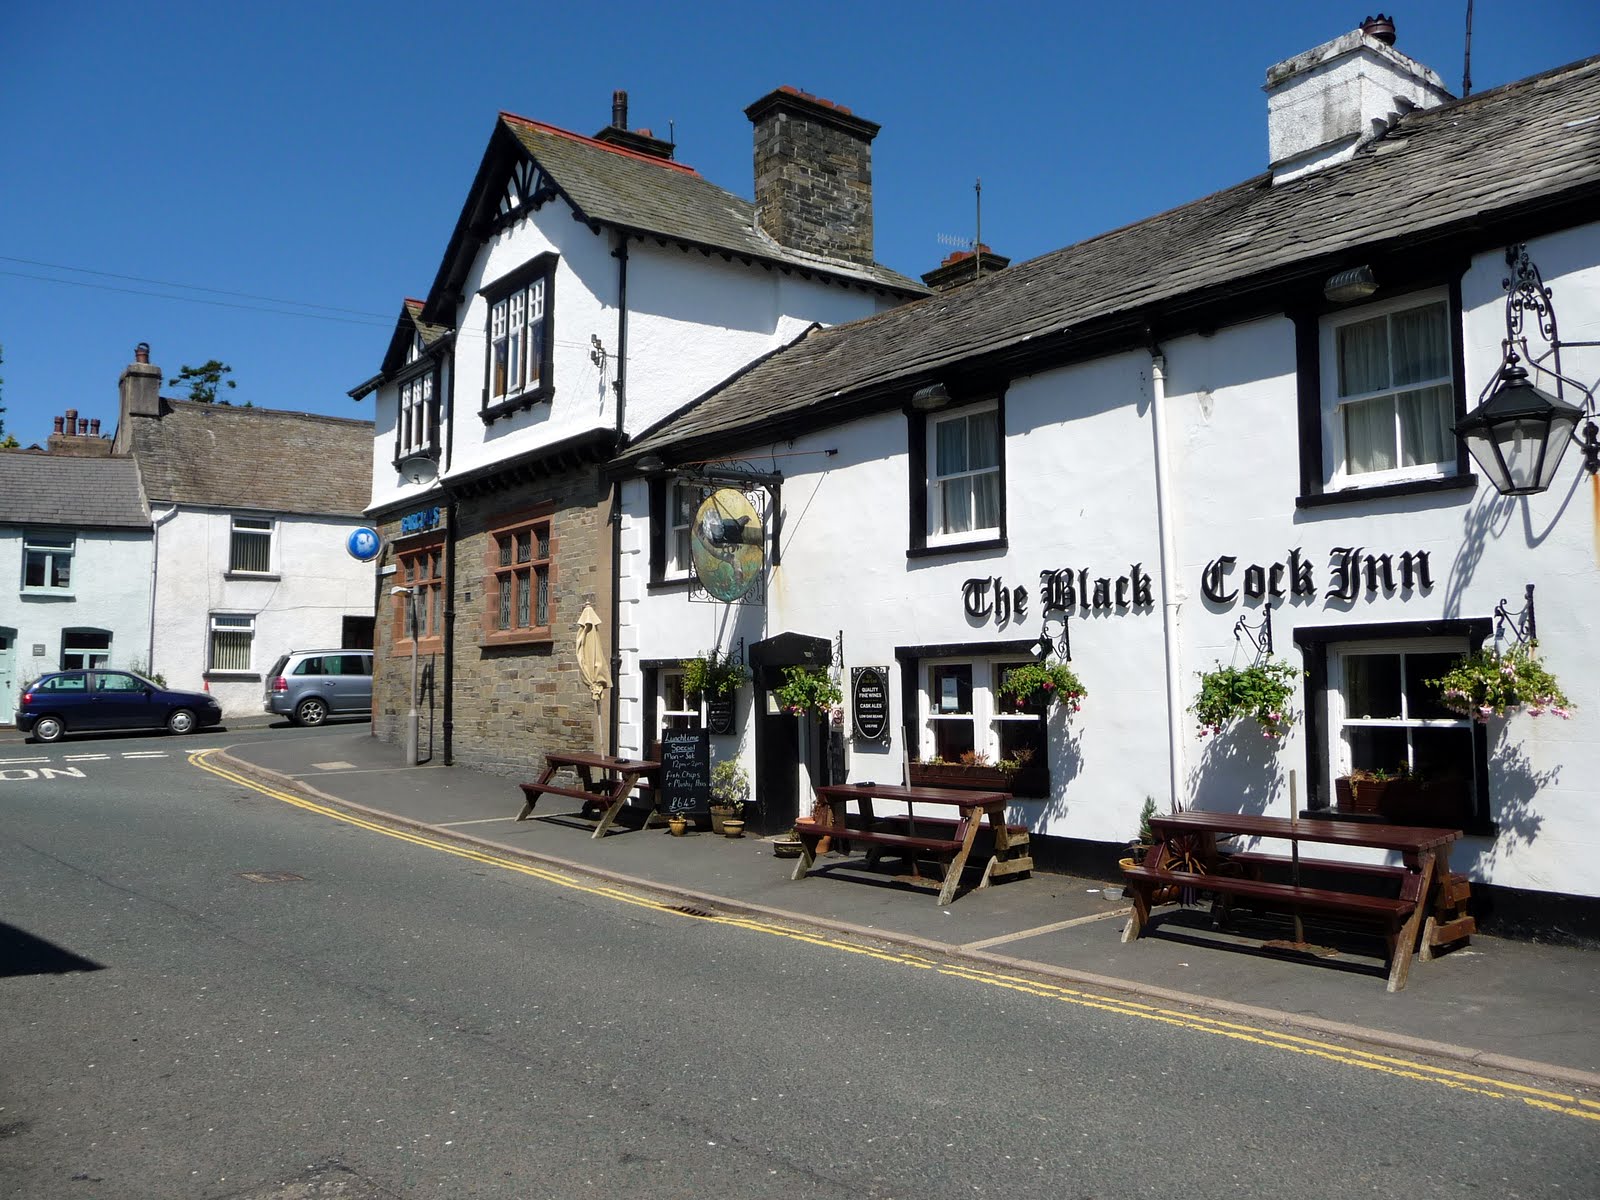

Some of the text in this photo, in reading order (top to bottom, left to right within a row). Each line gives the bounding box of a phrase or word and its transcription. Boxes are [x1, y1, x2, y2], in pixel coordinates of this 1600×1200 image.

[961, 546, 1435, 625] The Black Cock Inn
[671, 743, 696, 753] Special
